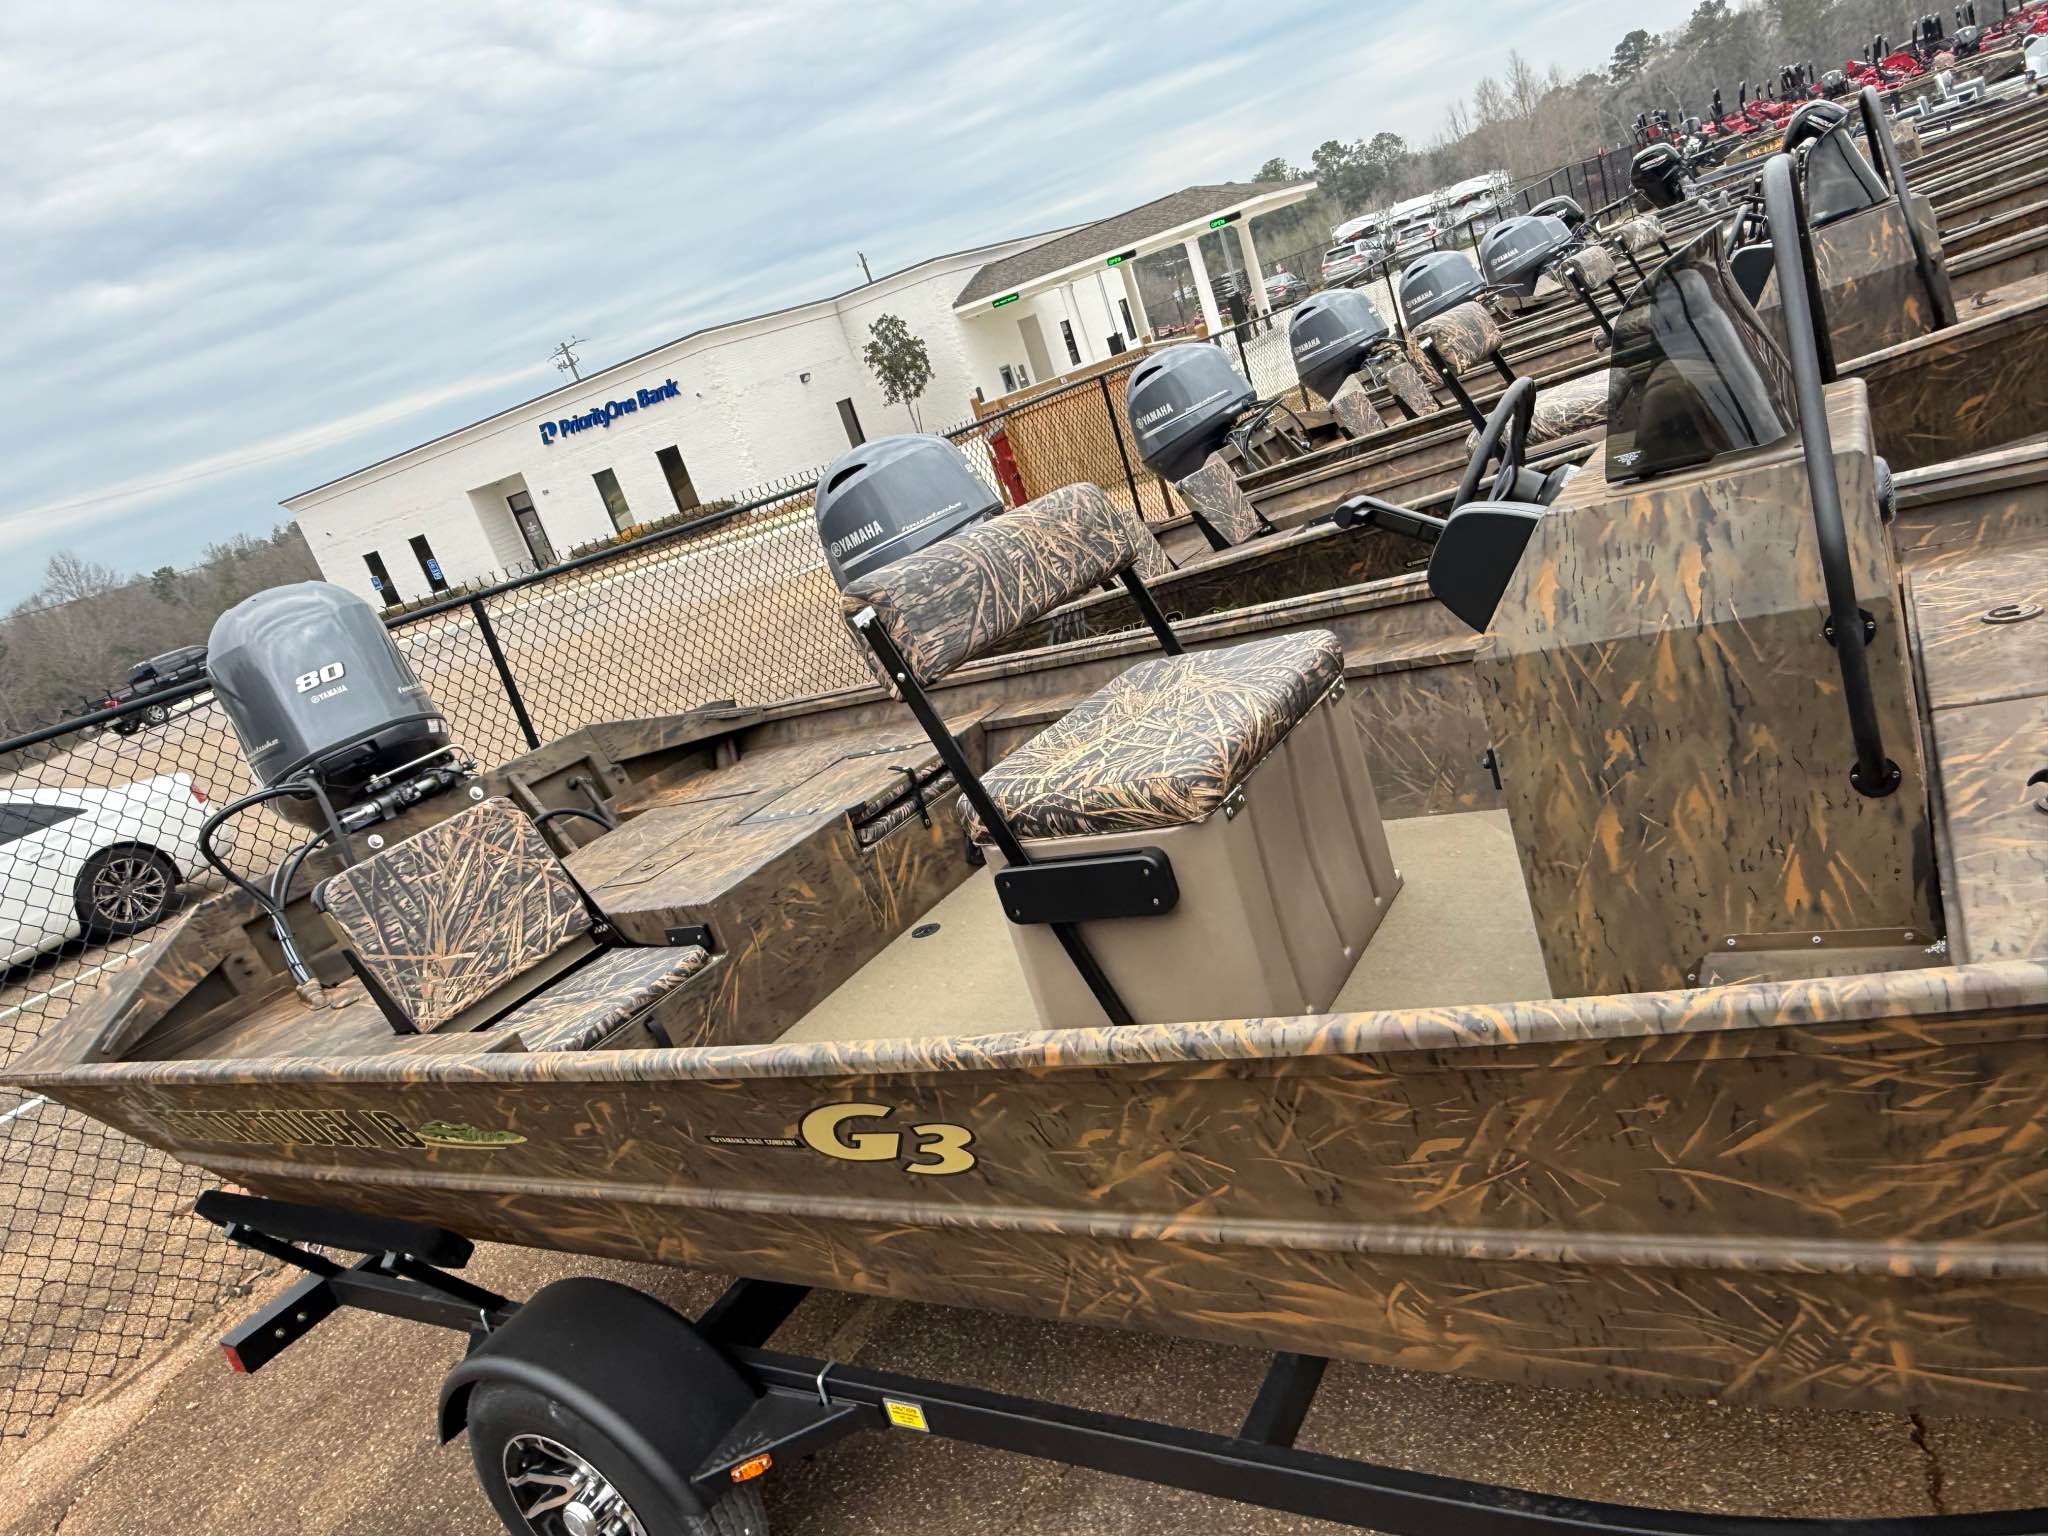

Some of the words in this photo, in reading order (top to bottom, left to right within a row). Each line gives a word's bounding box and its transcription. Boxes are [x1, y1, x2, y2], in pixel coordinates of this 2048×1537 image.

[559, 400, 637, 438] PriorityOne
[636, 378, 681, 408] Bank
[1141, 403, 1173, 425] YAMAHA
[839, 520, 883, 552] YAMAHA
[295, 662, 345, 693] 80
[318, 685, 348, 700] YAMAHA
[799, 1101, 979, 1175] G3
